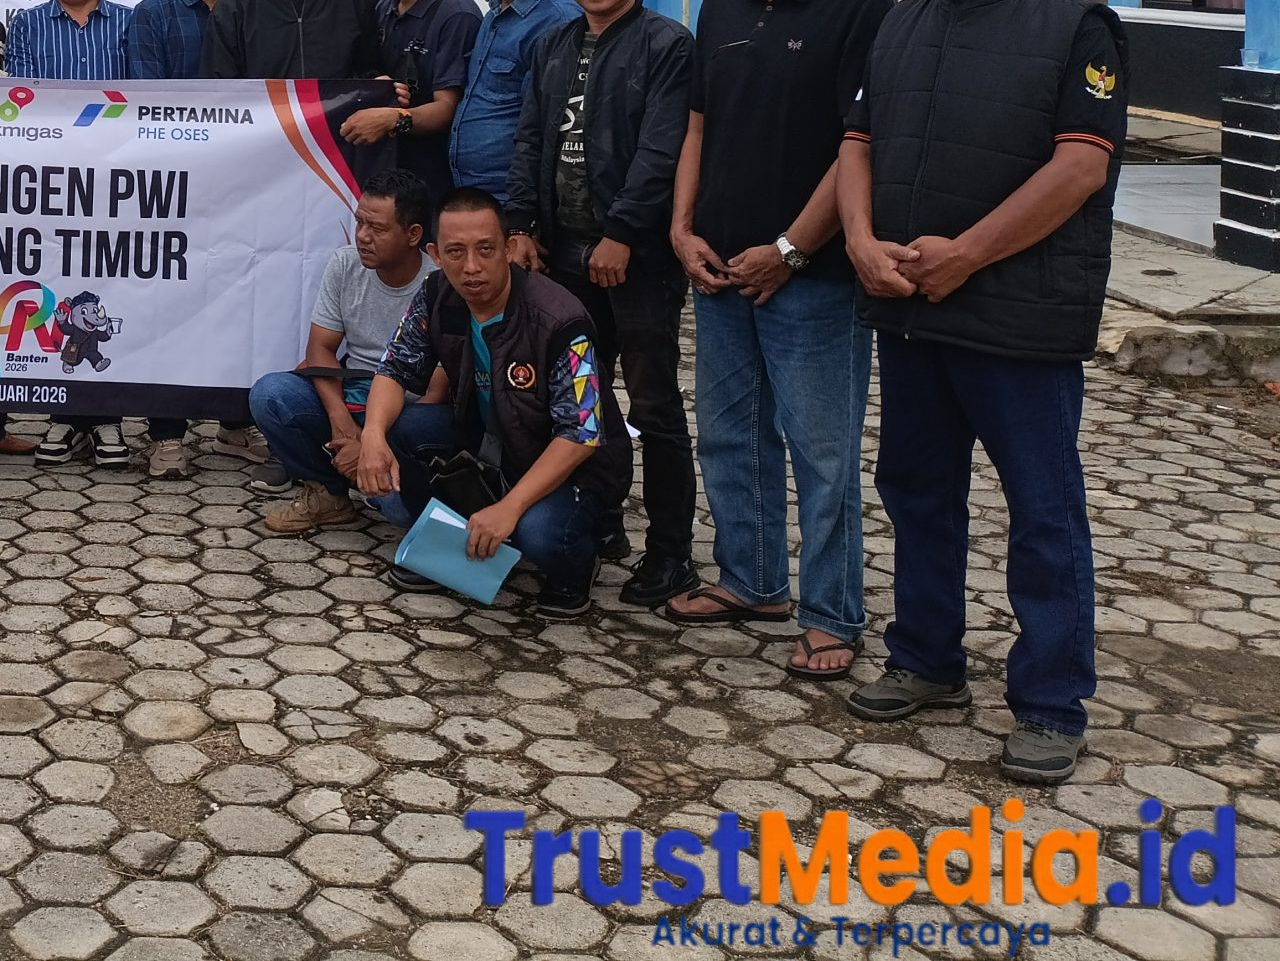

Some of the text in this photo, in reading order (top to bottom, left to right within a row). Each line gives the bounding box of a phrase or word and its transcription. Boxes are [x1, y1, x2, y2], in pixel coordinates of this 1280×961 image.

[137, 105, 254, 125] PERTAMINA
[138, 127, 209, 141] PHE OSES
[109, 168, 189, 219] PWI
[55, 229, 188, 280] TIMUR
[6, 353, 48, 363] Banten
[5, 363, 28, 372] 2026
[32, 385, 67, 403] 2026
